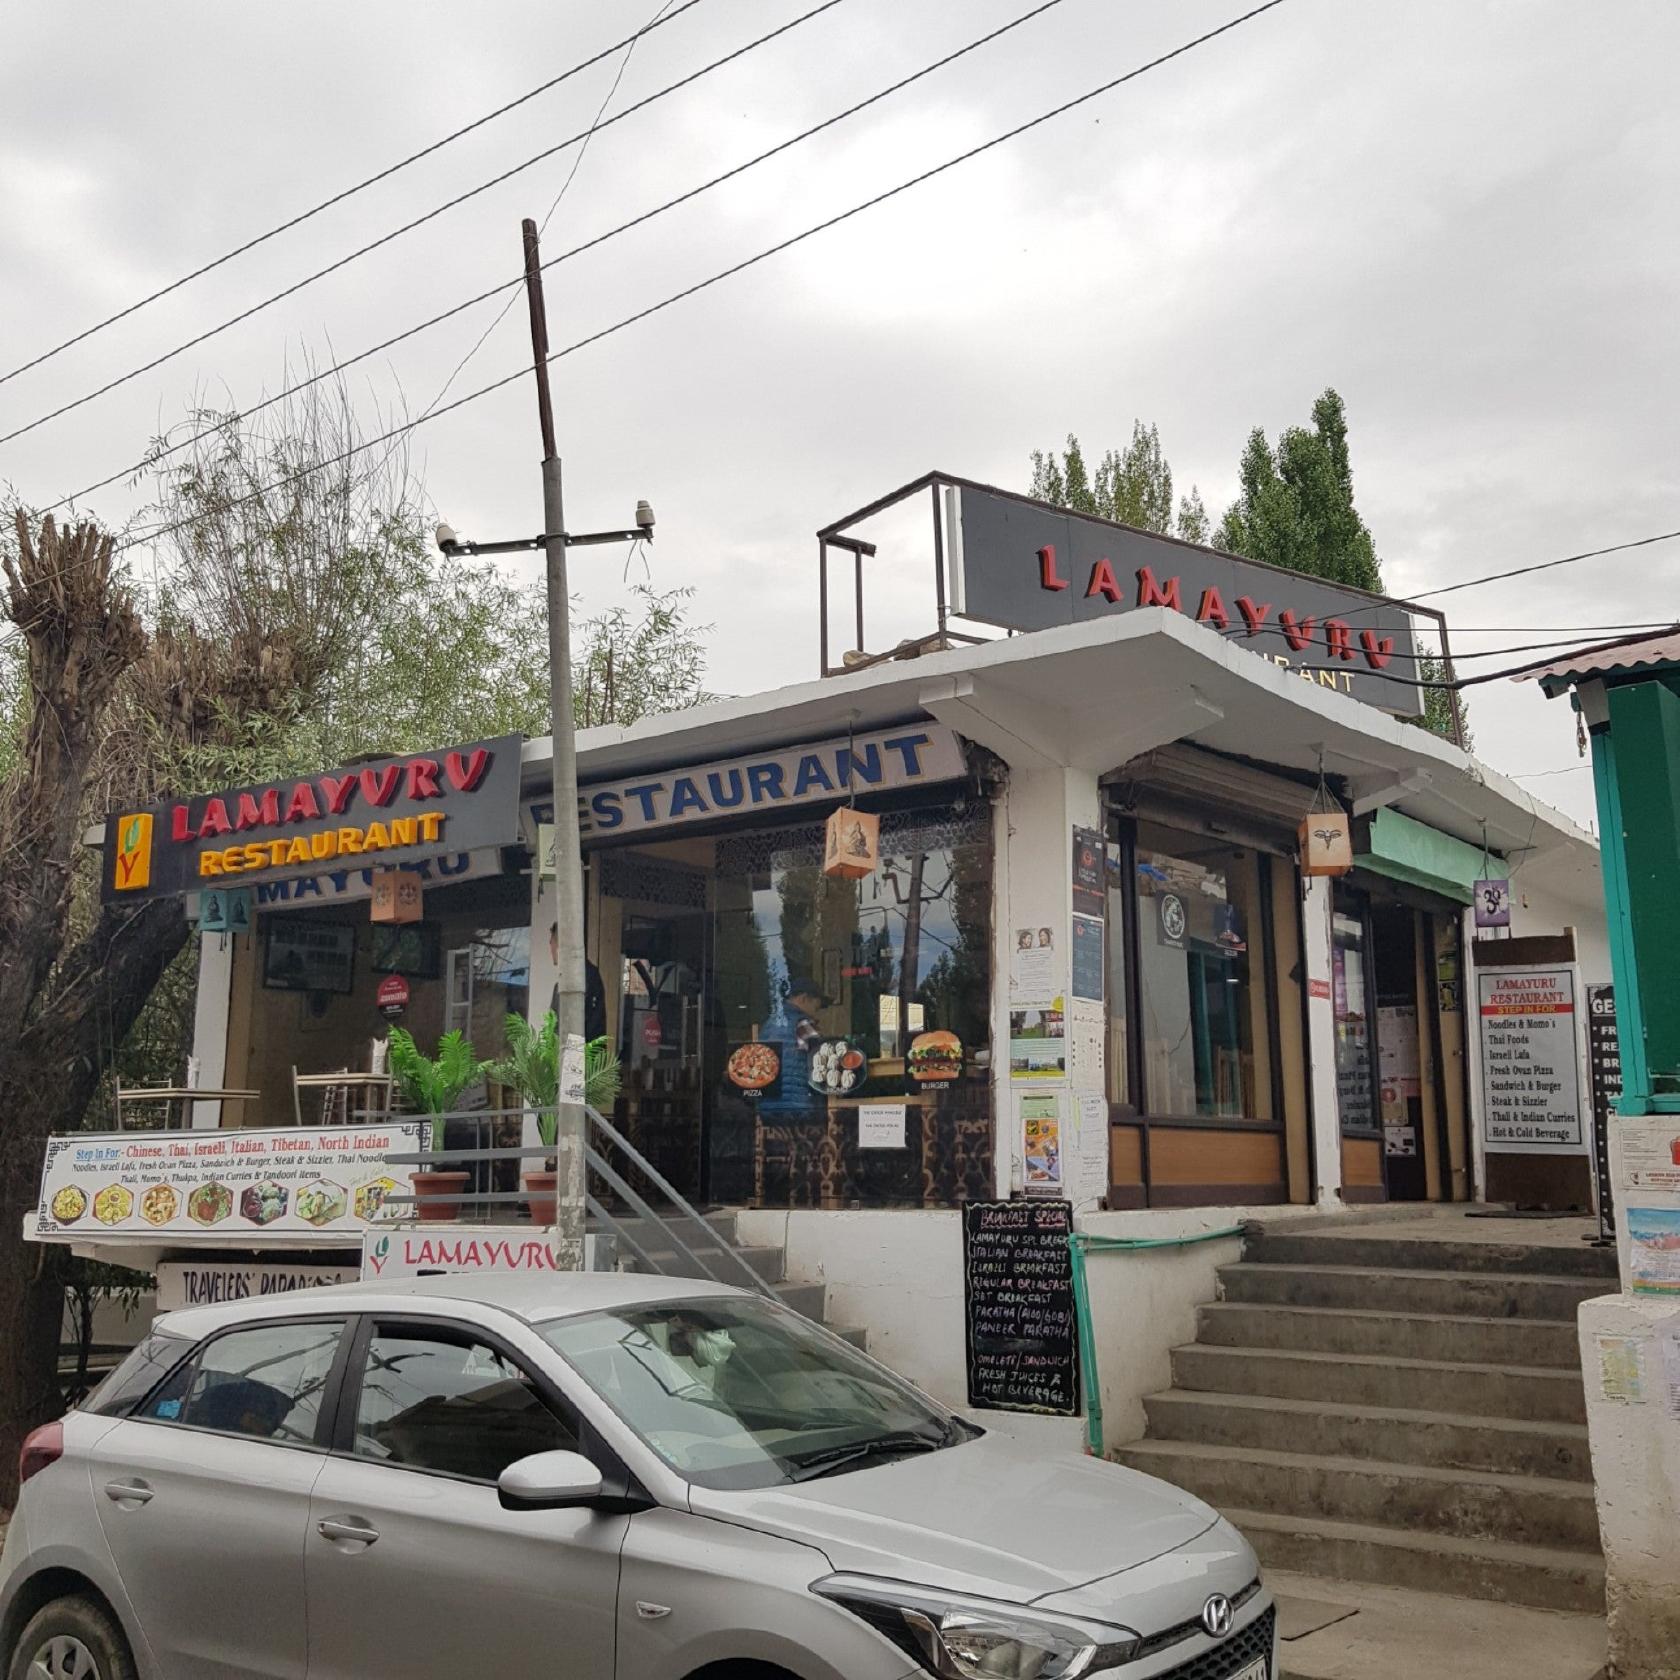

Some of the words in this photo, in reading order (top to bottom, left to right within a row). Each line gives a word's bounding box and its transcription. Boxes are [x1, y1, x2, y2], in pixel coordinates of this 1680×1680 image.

[1036, 544, 1393, 669] LAMAYURU
[172, 748, 491, 842] LAMAYURU
[200, 812, 445, 877] RESTAURANT
[1496, 978, 1557, 990] LAMAYURU
[1490, 992, 1564, 1004] RESTAURANT
[1497, 1006, 1522, 1015] STEP
[1524, 1006, 1533, 1014] IN
[1536, 1005, 1556, 1013] FOR
[1592, 999, 1616, 1014] GE
[1488, 1019, 1516, 1029] Noodles
[1519, 1019, 1525, 1029] &
[1488, 1035, 1505, 1045] Thai
[1507, 1034, 1529, 1044] Foods
[1490, 1065, 1510, 1075] Fresh
[1533, 1065, 1554, 1075] Pizza
[921, 1082, 949, 1090] BURGER
[1491, 1080, 1525, 1090] Sandwich
[1527, 1081, 1533, 1090] &
[1536, 1081, 1561, 1094] Burger
[1491, 1096, 1512, 1106] Steak
[1515, 1096, 1520, 1106] &
[1521, 1111, 1545, 1122] Indian
[1546, 1112, 1575, 1122] Curries
[1492, 1127, 1506, 1137] Hot
[1508, 1127, 1514, 1137] &
[1515, 1127, 1533, 1137] Cold
[1535, 1128, 1570, 1141] Beverage
[76, 1148, 94, 1160] Step
[126, 1145, 165, 1158] Chinese,
[318, 1136, 348, 1150] North
[354, 1134, 390, 1149] Indian
[358, 1152, 387, 1163] Noodle
[979, 1368, 1006, 1380] FRESH
[1011, 1371, 1047, 1383] JUICES
[983, 1383, 1002, 1394] HOT
